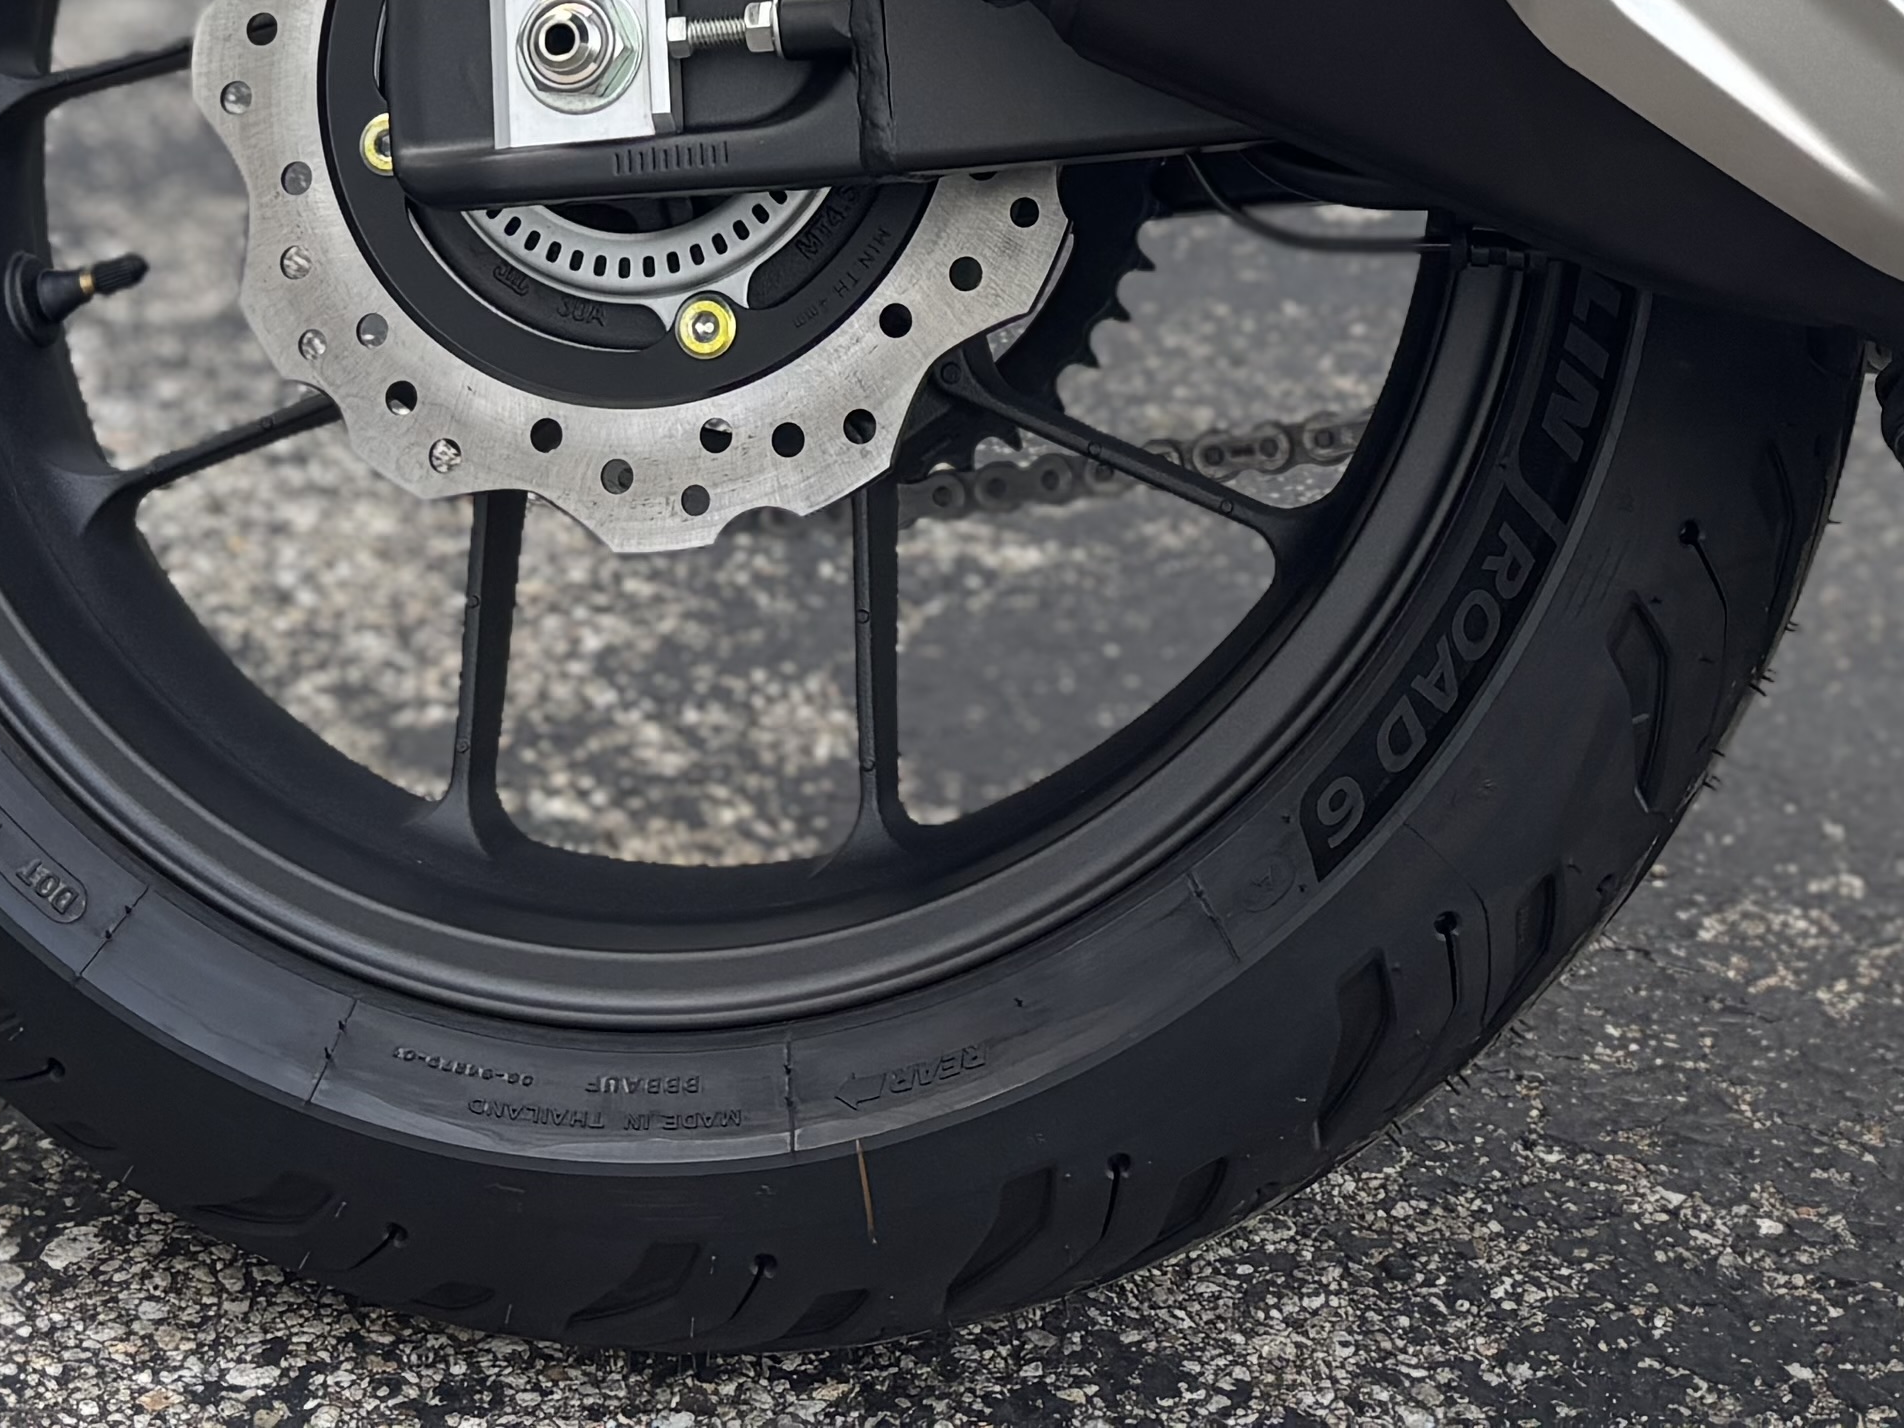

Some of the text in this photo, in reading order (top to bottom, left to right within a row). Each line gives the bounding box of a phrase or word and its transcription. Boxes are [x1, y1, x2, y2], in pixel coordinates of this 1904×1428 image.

[1316, 520, 1537, 849] ROAD 6
[15, 858, 80, 915] DOT
[889, 1044, 987, 1094] REAR
[467, 1098, 742, 1131] MADE IN THAILAND
